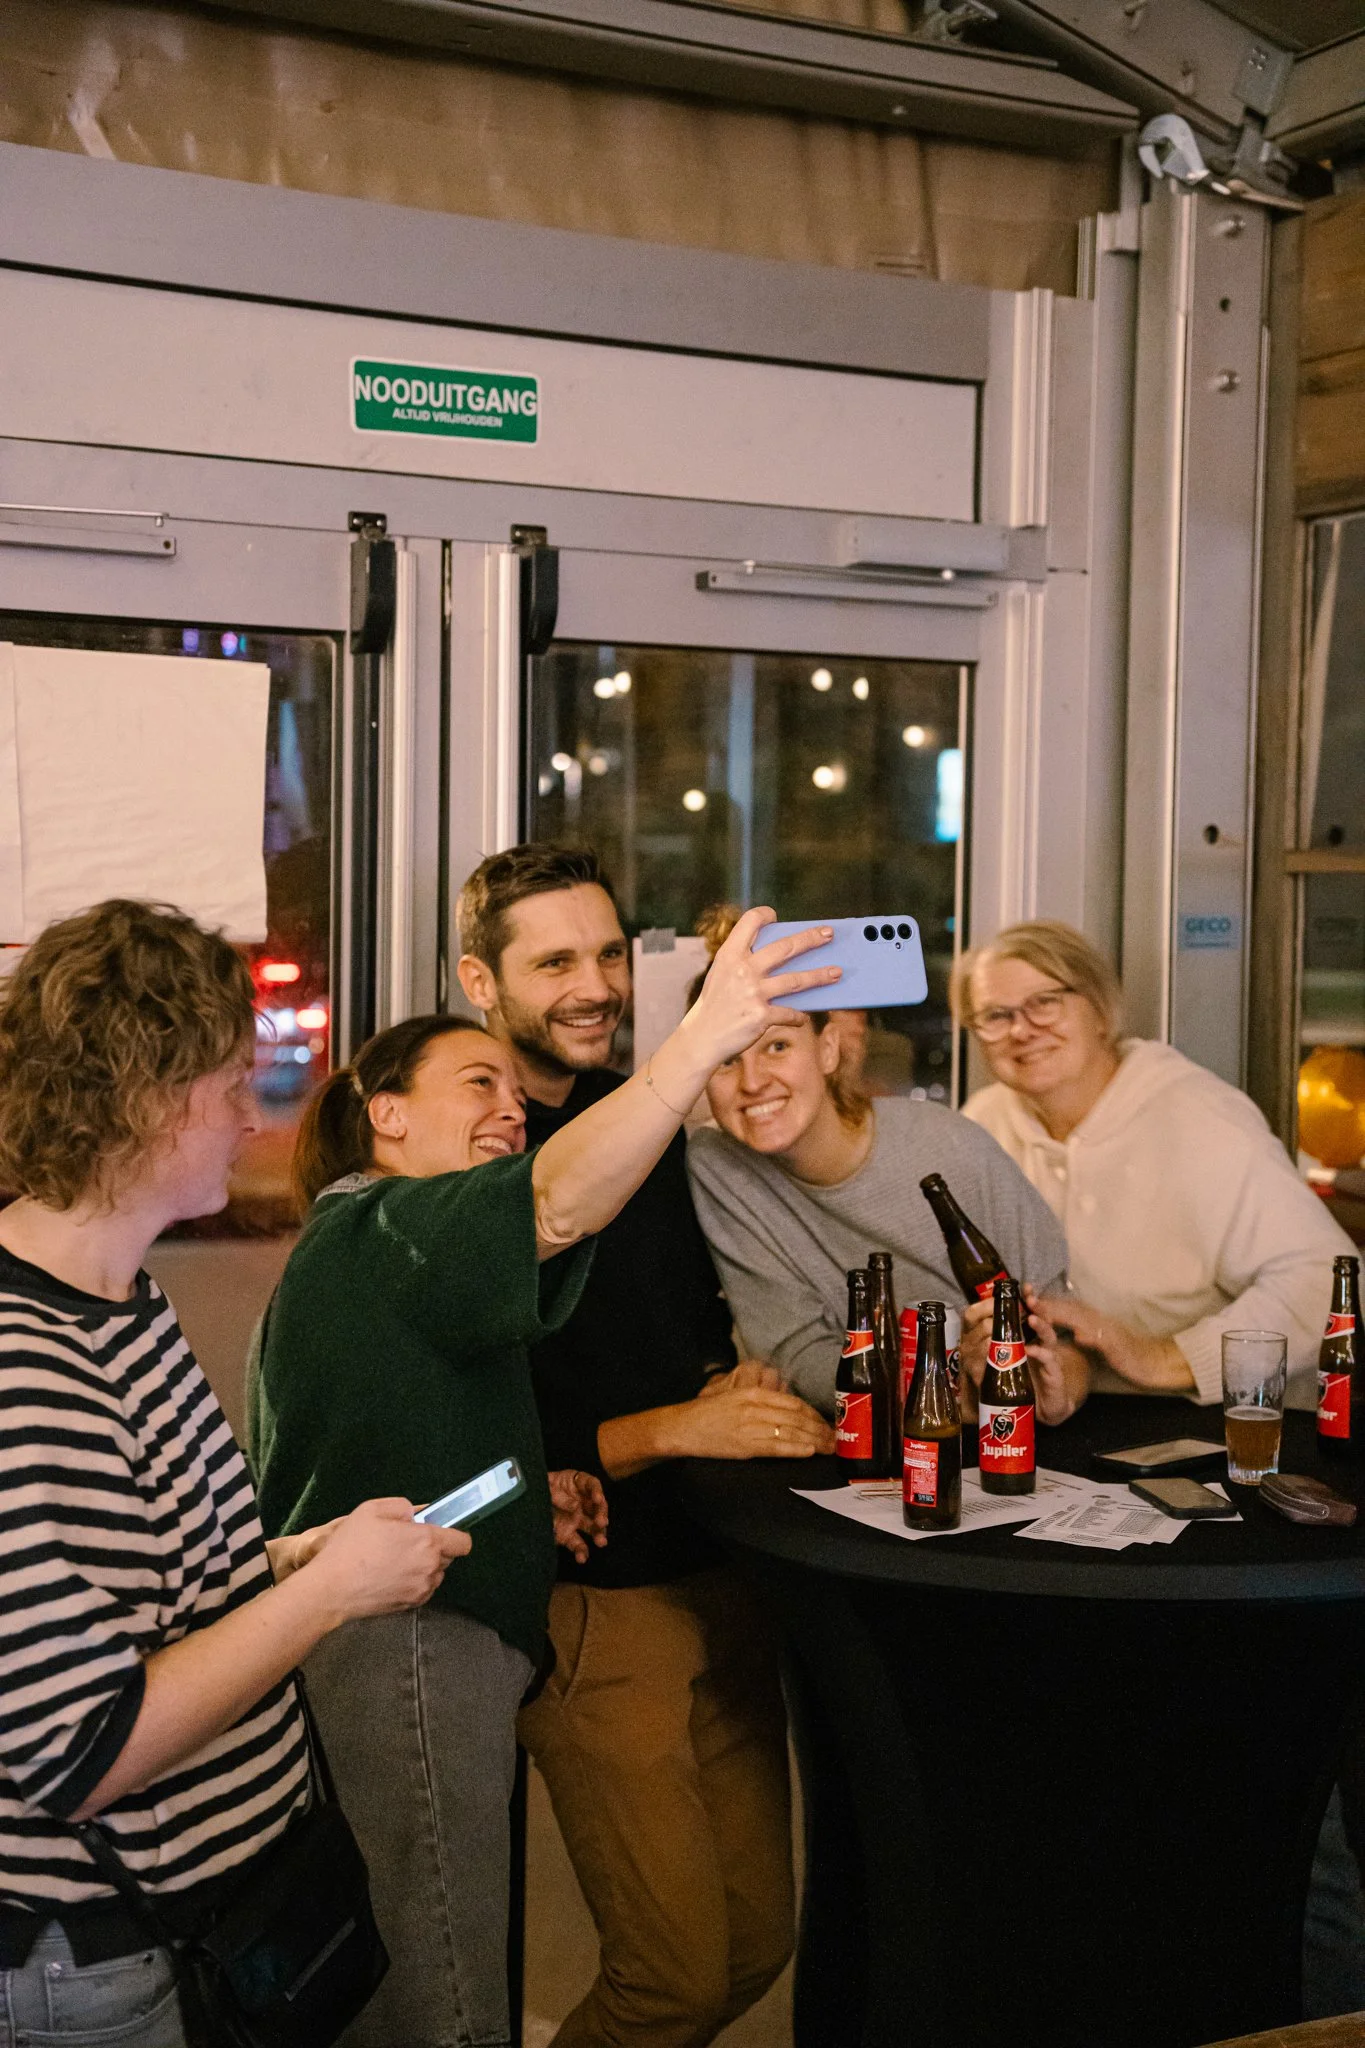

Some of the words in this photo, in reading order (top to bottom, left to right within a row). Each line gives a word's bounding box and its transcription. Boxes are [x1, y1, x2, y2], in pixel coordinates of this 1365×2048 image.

[355, 374, 537, 416] NOODUITGANG
[392, 407, 431, 422] ALTIJD
[982, 1441, 1028, 1460] Jupiler
